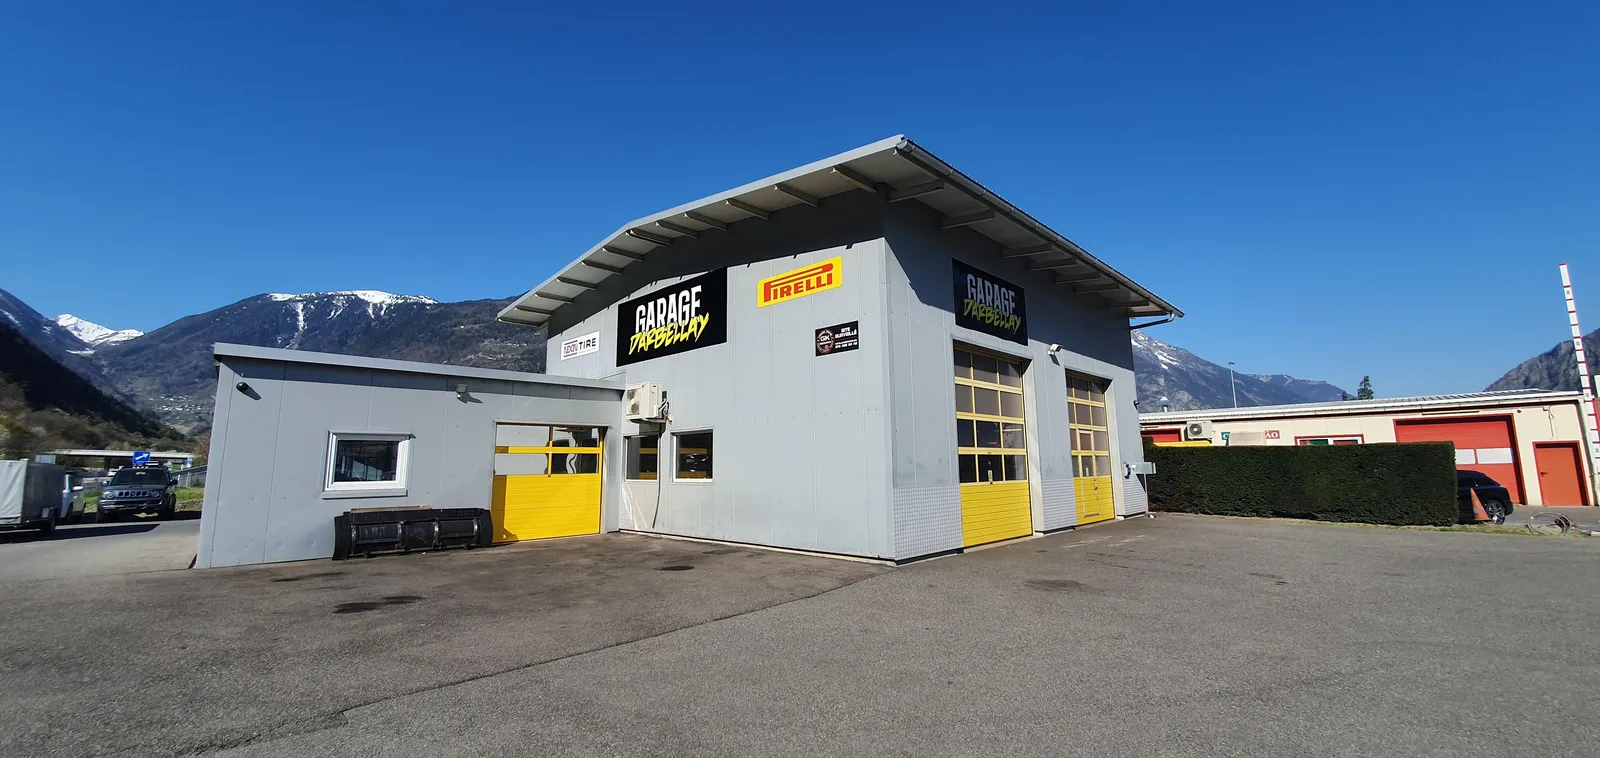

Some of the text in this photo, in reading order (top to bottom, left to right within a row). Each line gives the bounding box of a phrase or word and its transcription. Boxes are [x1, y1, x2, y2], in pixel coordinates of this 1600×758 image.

[764, 263, 833, 302] PIRELLI
[966, 273, 1015, 317] GARAGE
[635, 284, 702, 334] GARAGE
[963, 298, 1021, 335] DARBELLAY
[579, 337, 596, 350] TIRE
[628, 312, 709, 355] DARBELLAY
